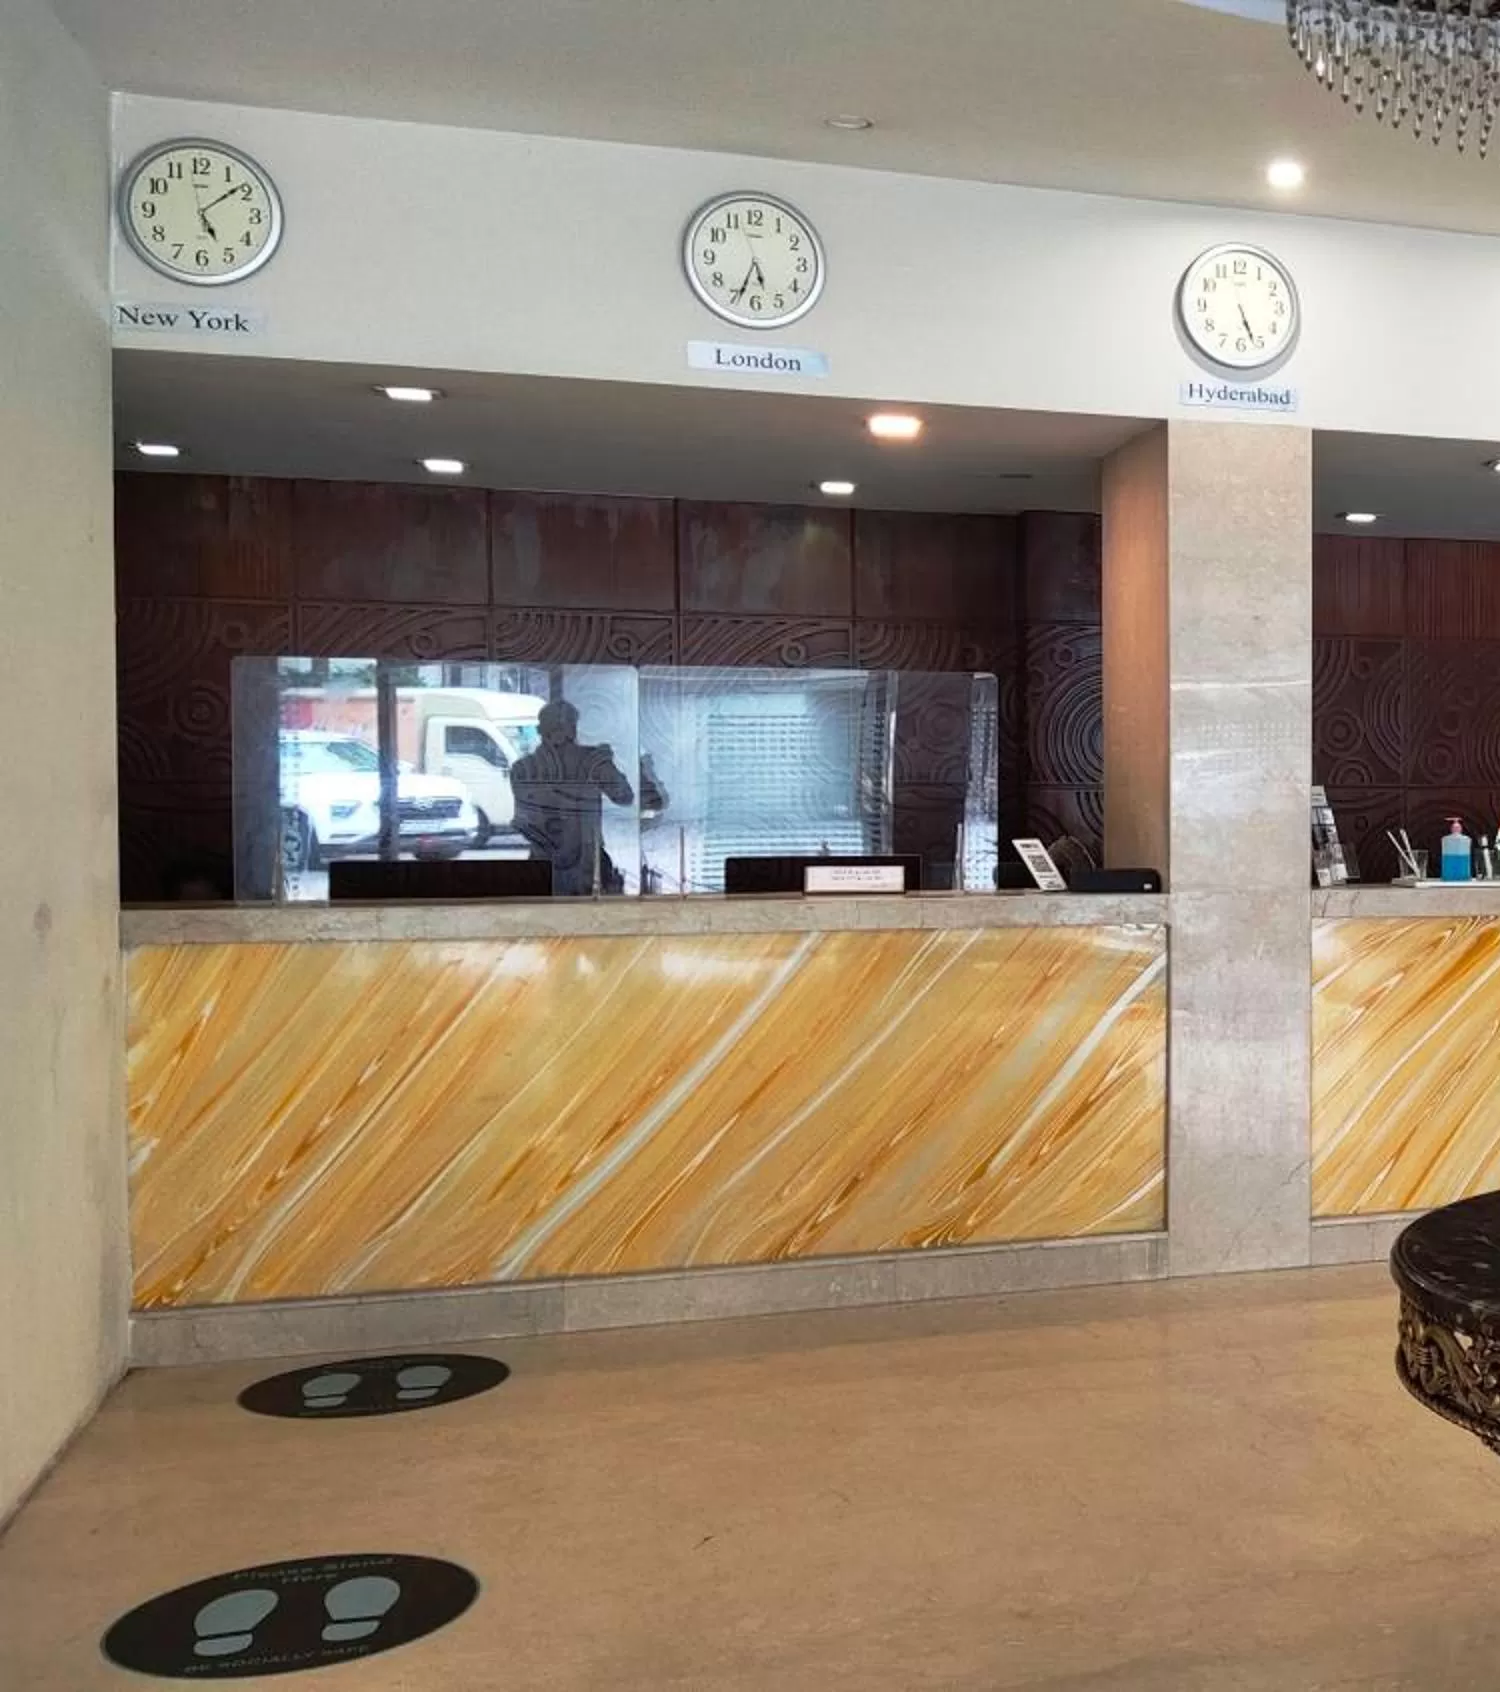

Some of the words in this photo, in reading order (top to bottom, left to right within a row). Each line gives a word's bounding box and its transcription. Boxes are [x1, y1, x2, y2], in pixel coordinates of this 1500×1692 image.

[168, 162, 183, 179] 11
[192, 158, 211, 175] 12
[225, 166, 231, 182] 1
[150, 178, 168, 194] 10
[241, 184, 252, 201] 2
[142, 202, 155, 218] 9
[250, 208, 261, 224] 3
[726, 213, 739, 229] 11
[747, 210, 763, 226] 12
[776, 217, 781, 233] 1
[153, 226, 165, 241] 8
[240, 232, 251, 246] 4
[710, 228, 726, 244] 10
[789, 236, 799, 251] 2
[172, 244, 184, 259] 7
[196, 250, 209, 266] 6
[223, 248, 234, 264] 5
[703, 250, 715, 265] 9
[796, 257, 807, 272] 3
[1216, 264, 1227, 278] 11
[1234, 260, 1247, 274] 12
[712, 272, 723, 287] 8
[1257, 267, 1261, 280] 1
[789, 279, 798, 293] 4
[1203, 278, 1216, 292] 10
[1268, 282, 1277, 296] 2
[750, 295, 761, 311] 6
[773, 294, 784, 308] 5
[1197, 298, 1206, 312] 9
[1274, 301, 1284, 315] 3
[117, 306, 179, 326] New
[188, 310, 249, 332] York
[1205, 318, 1214, 331] 8
[1269, 321, 1276, 334] 4
[1219, 333, 1228, 347] 7
[1235, 338, 1246, 352] 6
[1255, 336, 1264, 349] 5
[715, 348, 801, 371] London
[1189, 383, 1290, 404] Hyderabad
